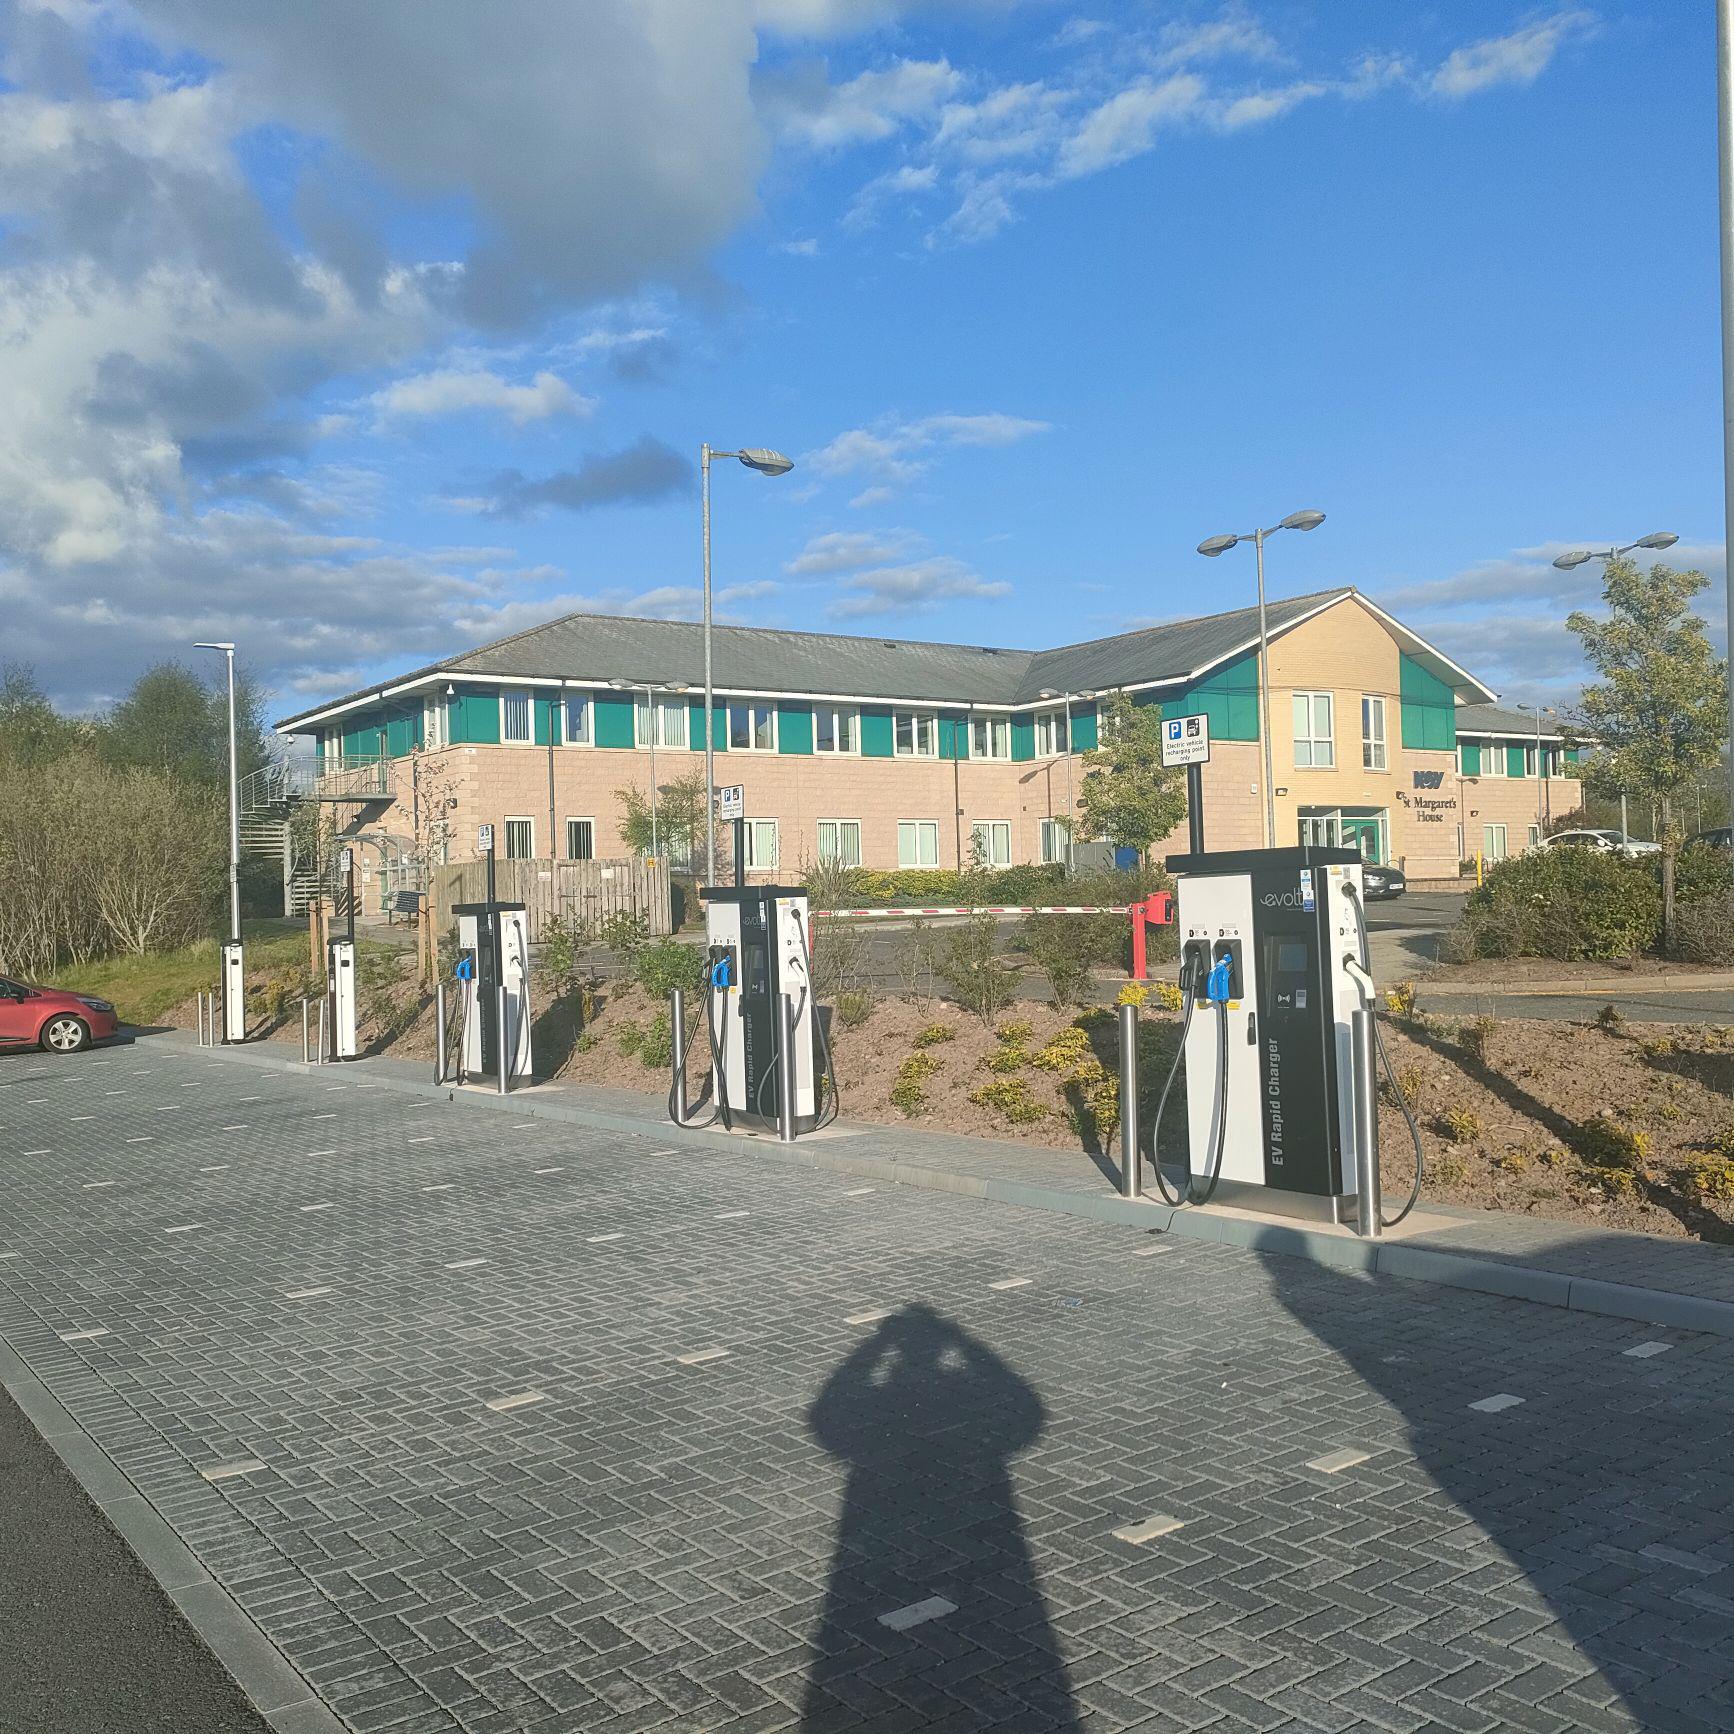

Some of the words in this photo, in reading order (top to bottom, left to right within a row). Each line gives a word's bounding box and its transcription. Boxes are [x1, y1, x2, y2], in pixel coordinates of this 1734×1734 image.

[1165, 748, 1191, 756] recharging
[1191, 745, 1205, 753] point
[1403, 798, 1411, 808] St
[1413, 796, 1457, 812] Margaret's
[1416, 810, 1443, 822] House
[1260, 887, 1304, 906] evolt
[1268, 1037, 1280, 1096] Charger
[1269, 1100, 1284, 1142] Rapid
[1271, 1146, 1284, 1166] EV
